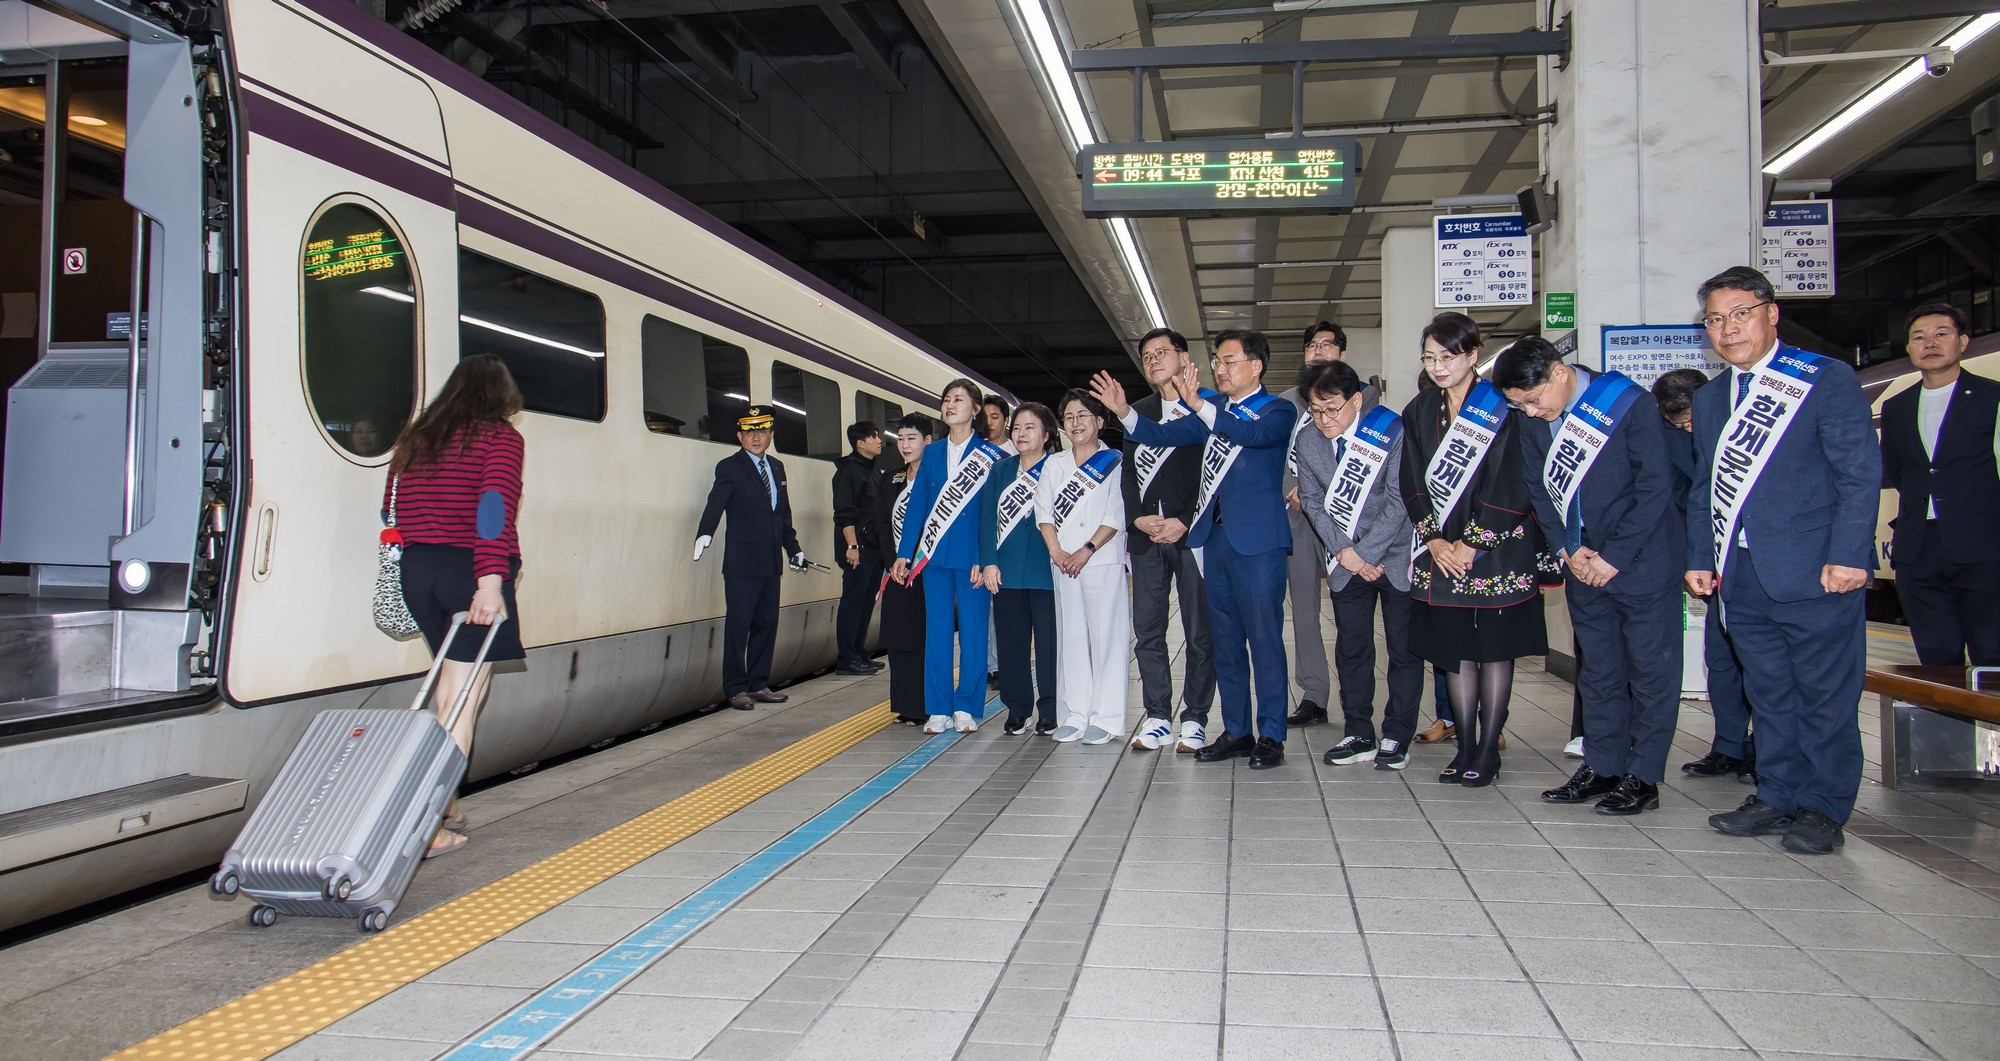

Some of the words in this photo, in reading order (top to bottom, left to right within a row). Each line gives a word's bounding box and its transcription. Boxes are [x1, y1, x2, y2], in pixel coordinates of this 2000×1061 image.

[1123, 153, 1164, 167] 출발시간
[1171, 152, 1205, 166] 도착역
[1228, 151, 1273, 164] 열차종류
[1123, 168, 1163, 182] 09:44
[1303, 166, 1329, 179] 415
[1444, 222, 1481, 233] 호차번호
[1442, 242, 1460, 250] KTX
[1785, 273, 1805, 281] 새마을
[1610, 336, 1650, 345] 복합열차
[1653, 335, 1702, 344] 이용안내문
[1778, 355, 1819, 374] 조국혁신당
[1760, 374, 1785, 392] 행복할
[1784, 384, 1805, 399] 권리
[1237, 405, 1261, 421] 조국혁신당
[1465, 405, 1499, 424] 조국혁신당
[1579, 401, 1614, 427] 조국혁신당
[1361, 425, 1391, 444] 조국혁신당
[1453, 421, 1476, 438] 행복할
[1474, 432, 1491, 446] 권리
[1564, 420, 1588, 440] 행복할
[1585, 434, 1603, 449] 권리
[1350, 442, 1370, 457] 행복할
[1368, 450, 1384, 463] 권리
[1083, 463, 1105, 480] 조국혁신당
[935, 459, 986, 522] 함께웃는
